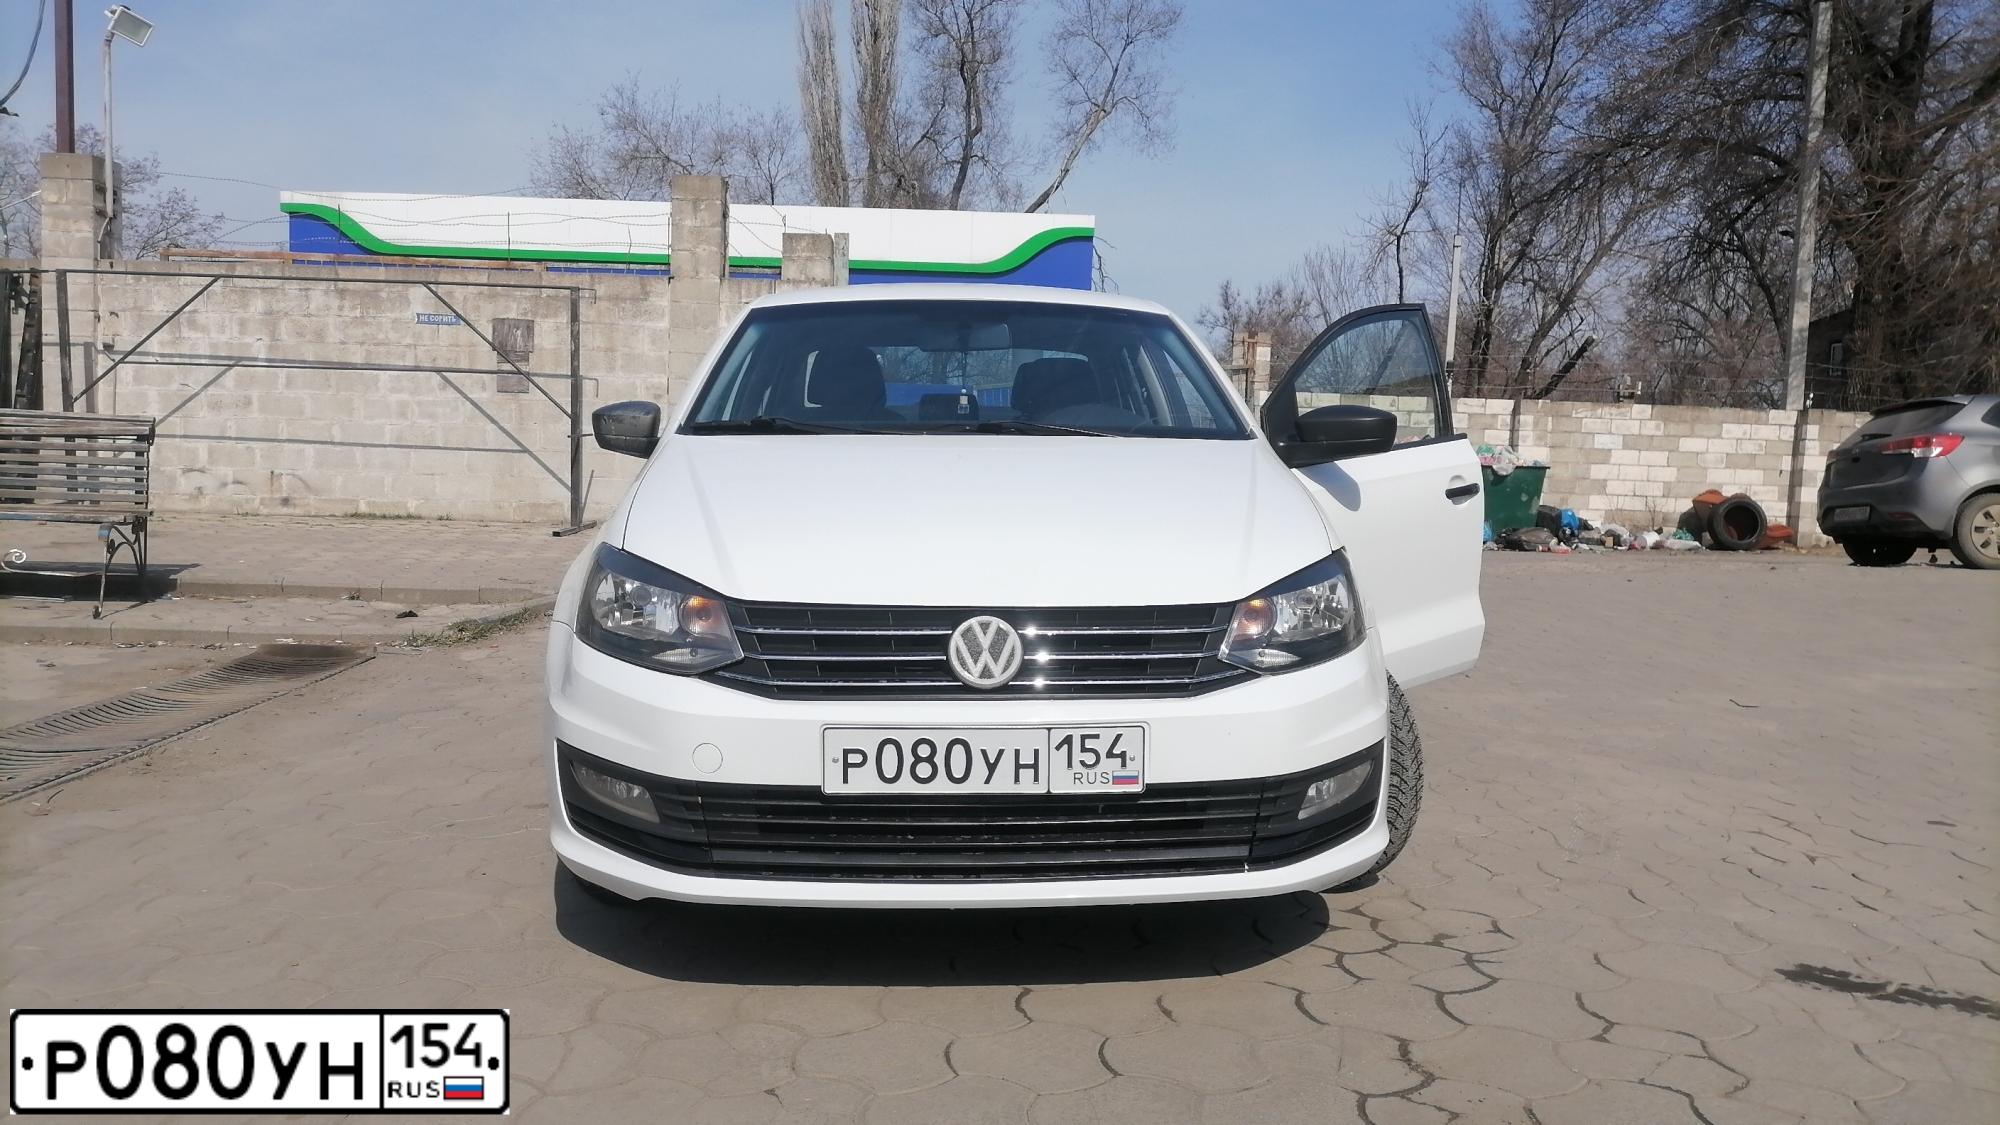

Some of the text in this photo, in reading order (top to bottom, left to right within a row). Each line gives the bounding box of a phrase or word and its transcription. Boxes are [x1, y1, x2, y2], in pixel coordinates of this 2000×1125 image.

[420, 314, 429, 322] НЕ
[842, 733, 1128, 785] Р080УН 154
[1073, 772, 1110, 785] RUS
